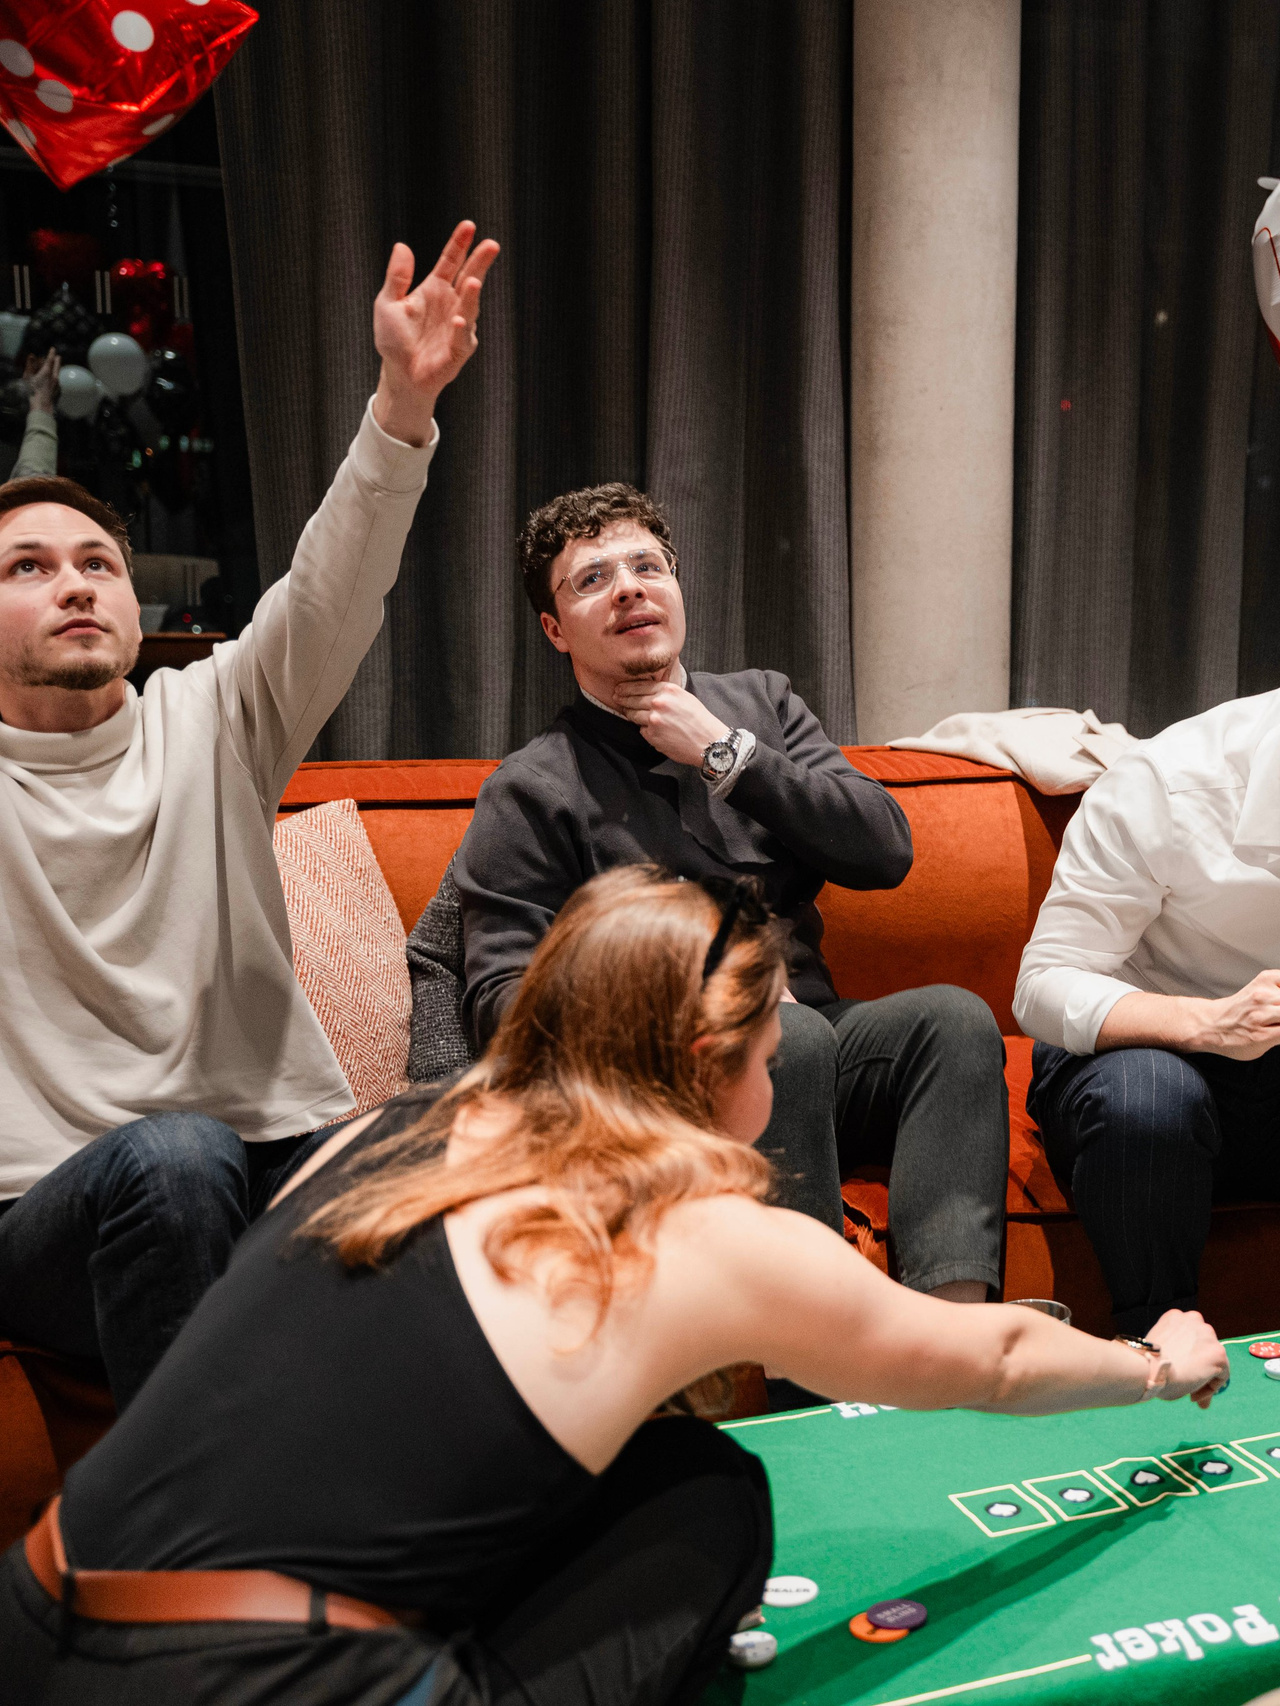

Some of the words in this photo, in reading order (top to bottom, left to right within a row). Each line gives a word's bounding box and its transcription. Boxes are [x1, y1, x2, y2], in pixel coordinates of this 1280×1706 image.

[875, 1603, 911, 1619] SMALL
[887, 1607, 917, 1622] BLIND
[1090, 1604, 1280, 1671] Poker
